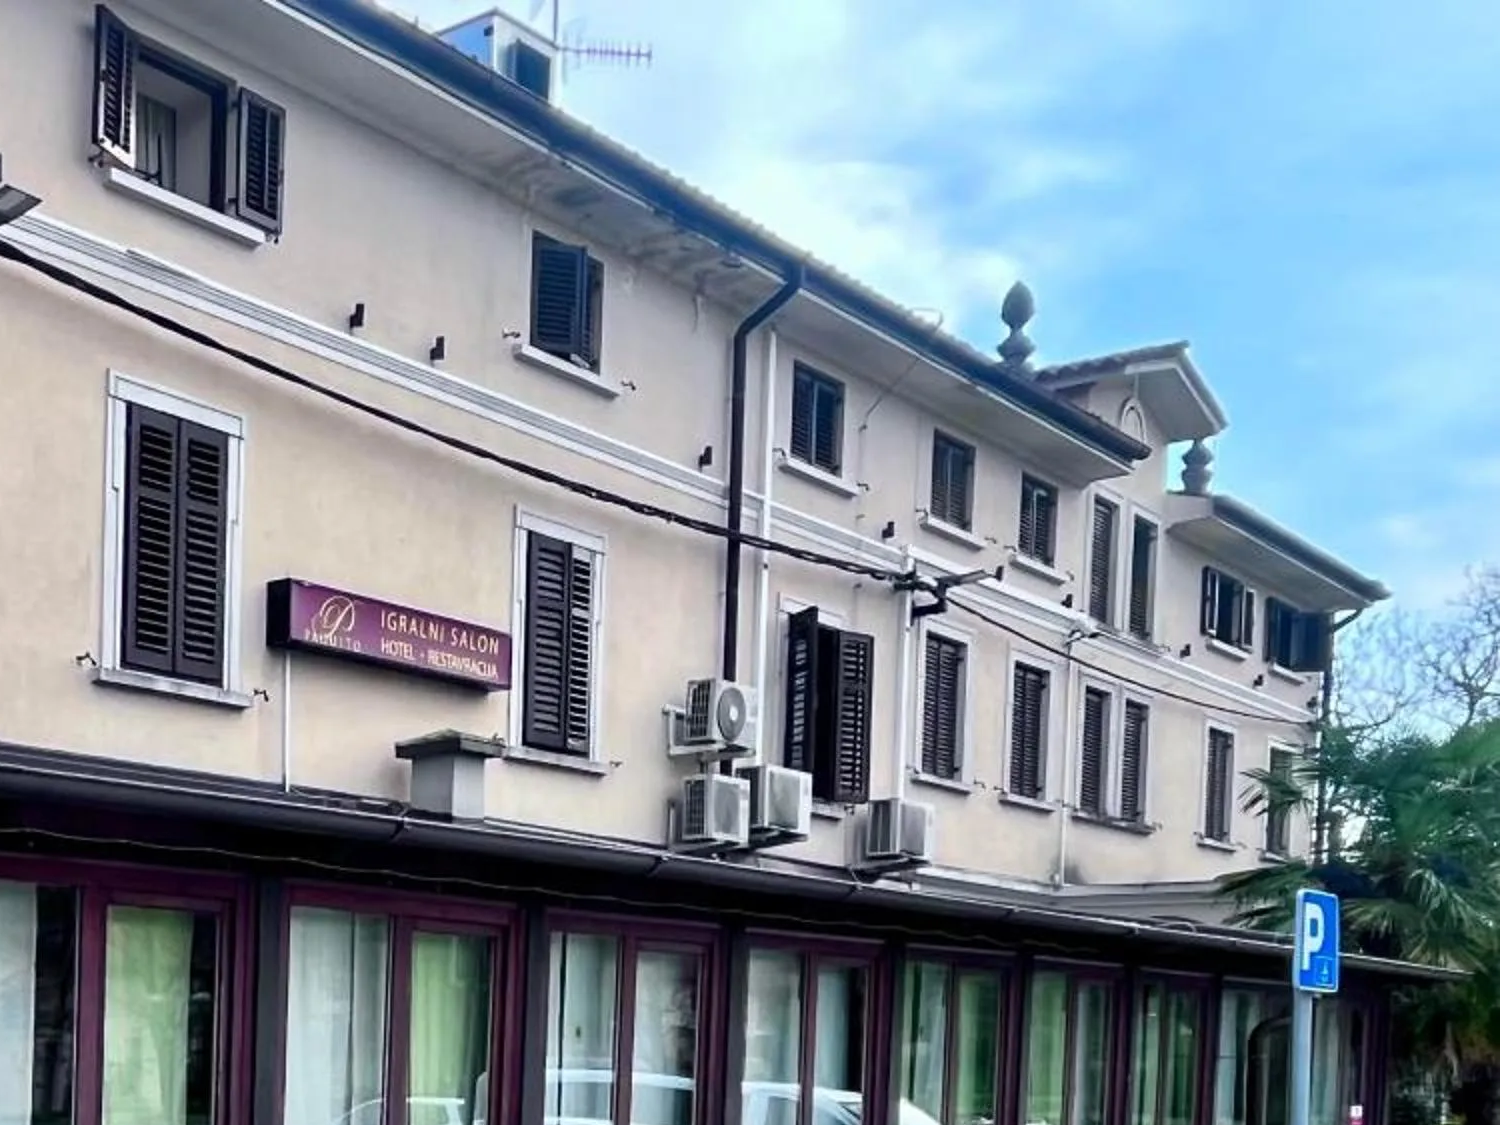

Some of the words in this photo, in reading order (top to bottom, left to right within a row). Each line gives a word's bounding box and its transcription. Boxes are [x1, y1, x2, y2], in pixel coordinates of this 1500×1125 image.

[380, 609, 445, 643] IGRALNI
[451, 627, 499, 655] SALON
[380, 637, 415, 660] HOTEL
[1302, 902, 1325, 970] P
